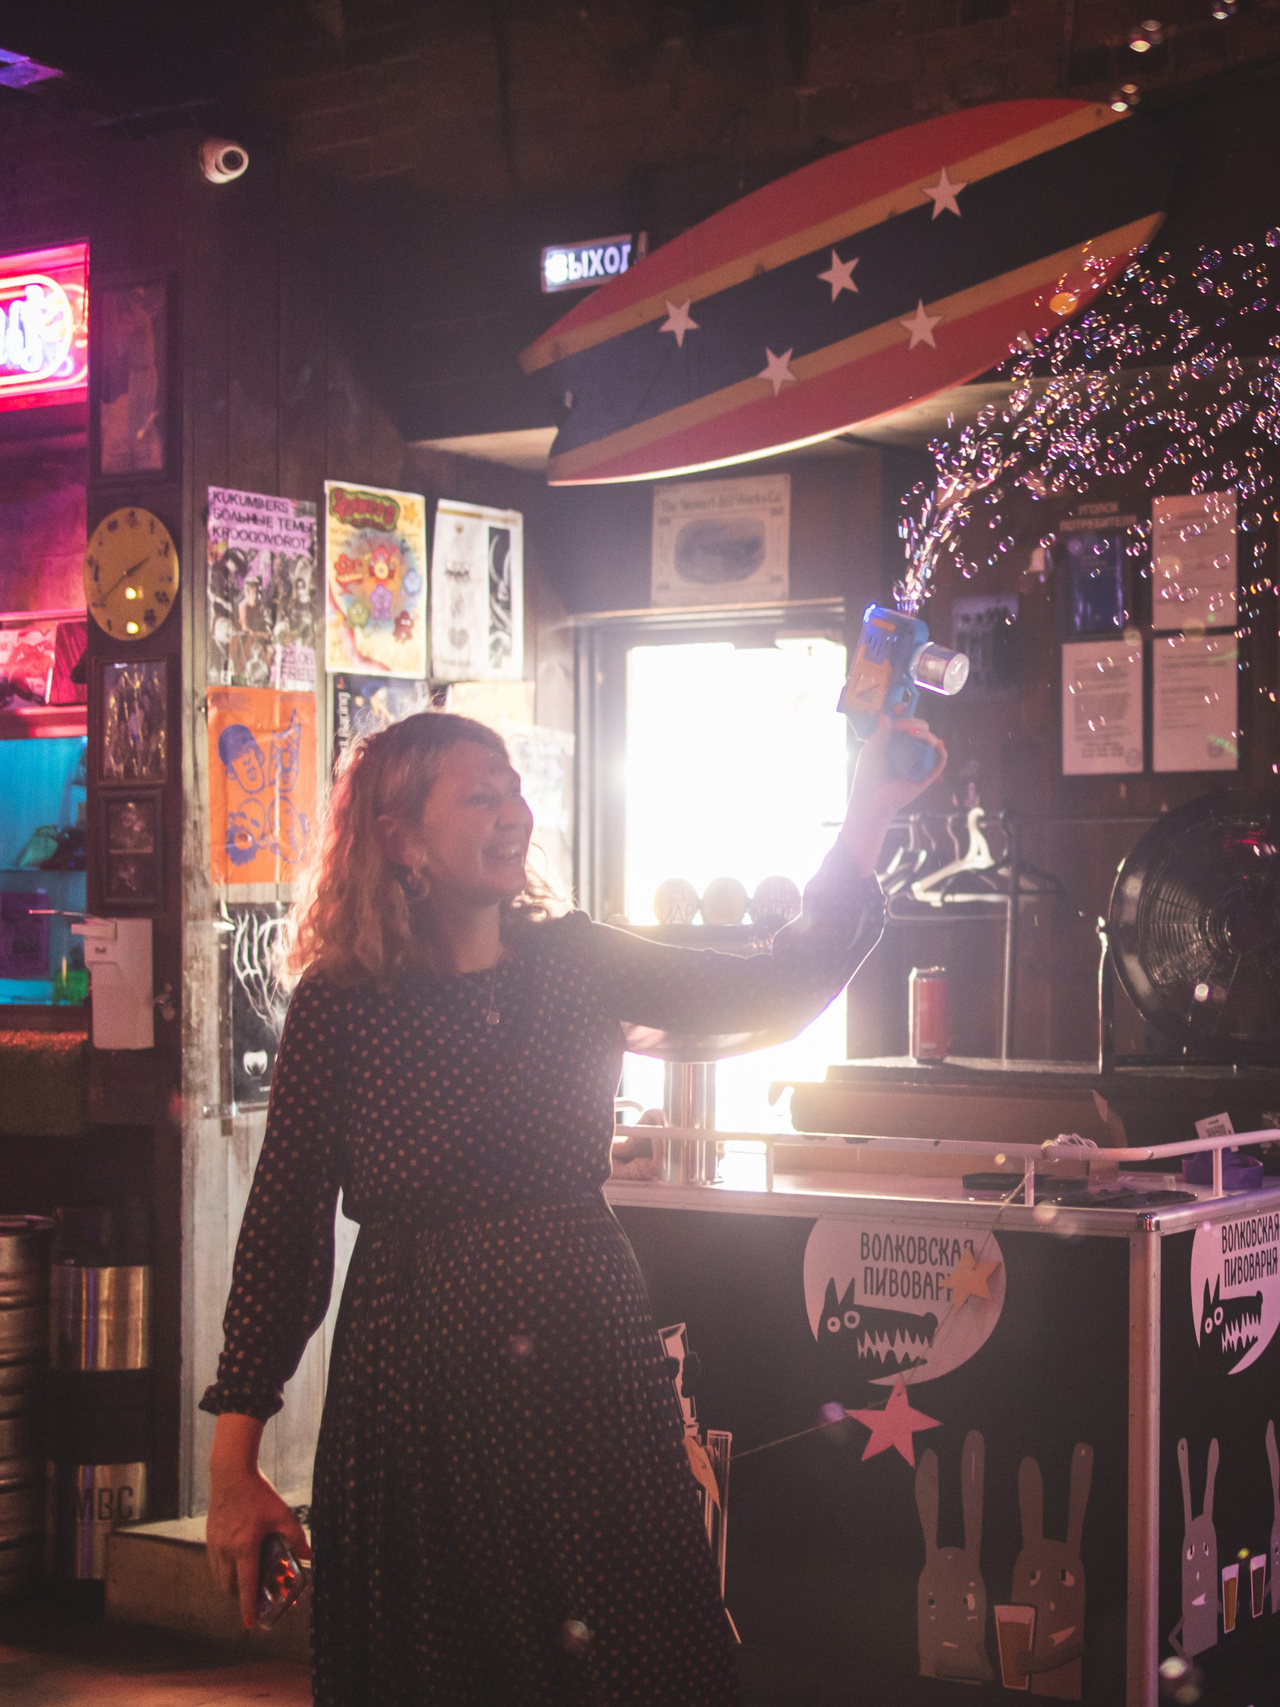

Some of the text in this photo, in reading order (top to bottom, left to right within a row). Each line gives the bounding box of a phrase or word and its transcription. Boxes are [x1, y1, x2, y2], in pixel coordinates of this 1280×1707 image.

[213, 491, 289, 513] KUKUMBERS
[213, 508, 274, 528] БОЛЬНЫЕ
[212, 526, 307, 549] KROOGOVOROT
[1222, 1213, 1280, 1254] ВОЛКОВСКАЯ
[1224, 1247, 1278, 1288] ПИВОВАРНЯ
[864, 1266, 953, 1302] ПИВОВАР
